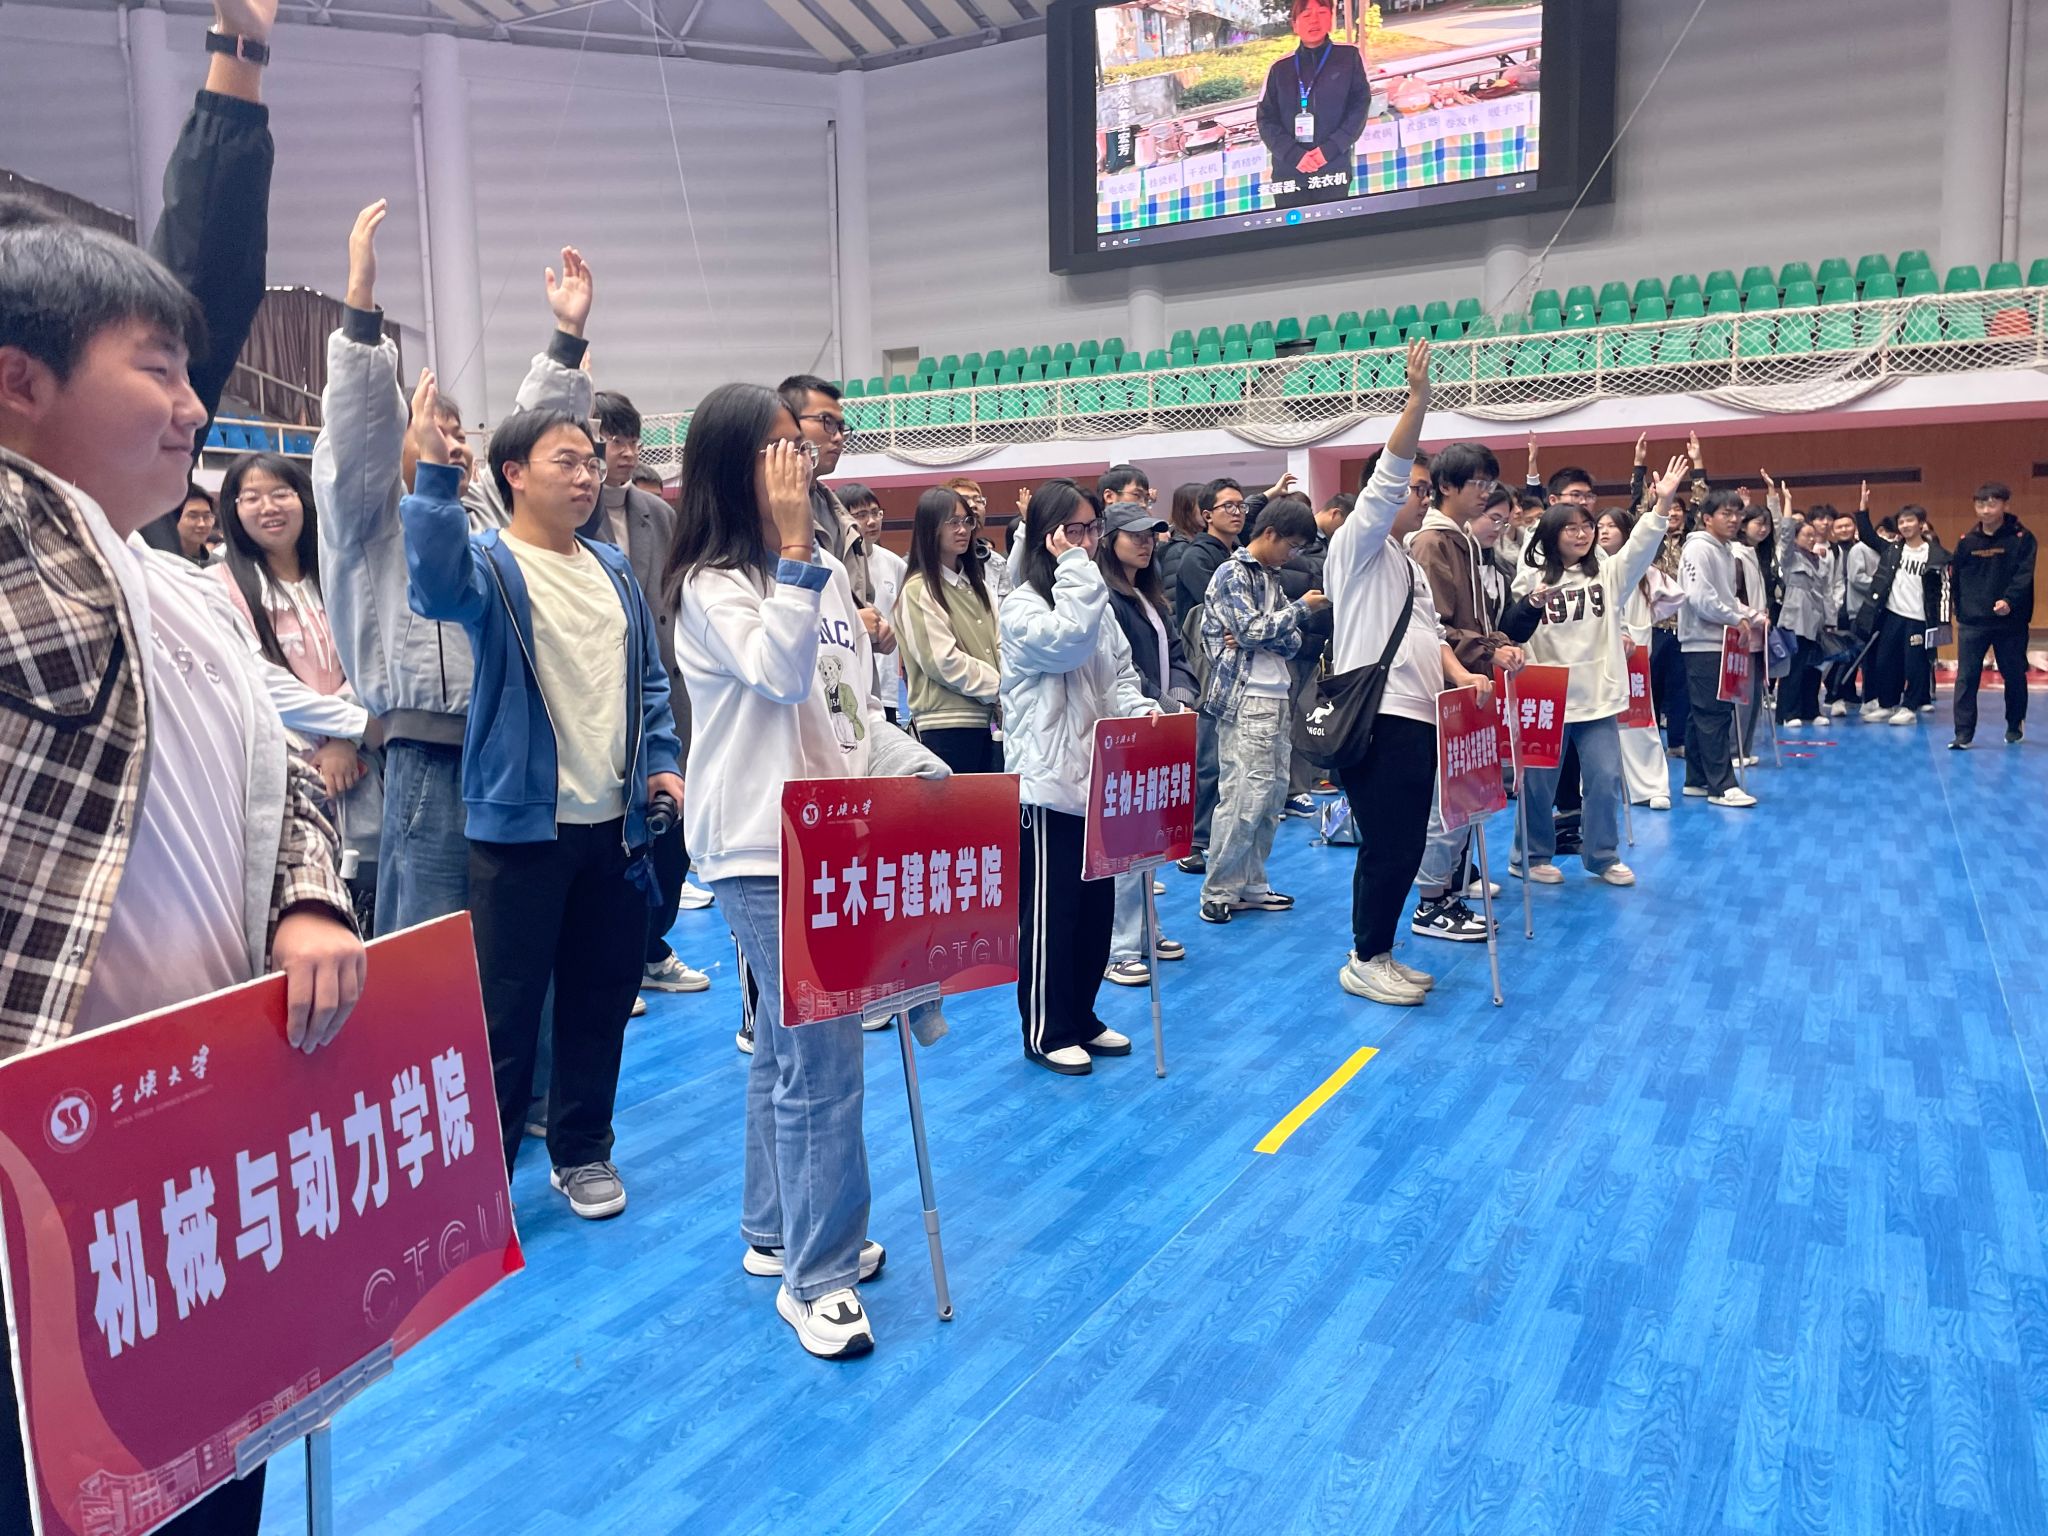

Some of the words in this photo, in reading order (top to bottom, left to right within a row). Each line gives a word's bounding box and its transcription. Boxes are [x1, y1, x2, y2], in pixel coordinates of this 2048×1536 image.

[1103, 761, 1191, 818] 生物与制药学院
[811, 844, 1003, 930] 土木与建筑学院
[88, 1046, 476, 1359] 机械与动力学院
